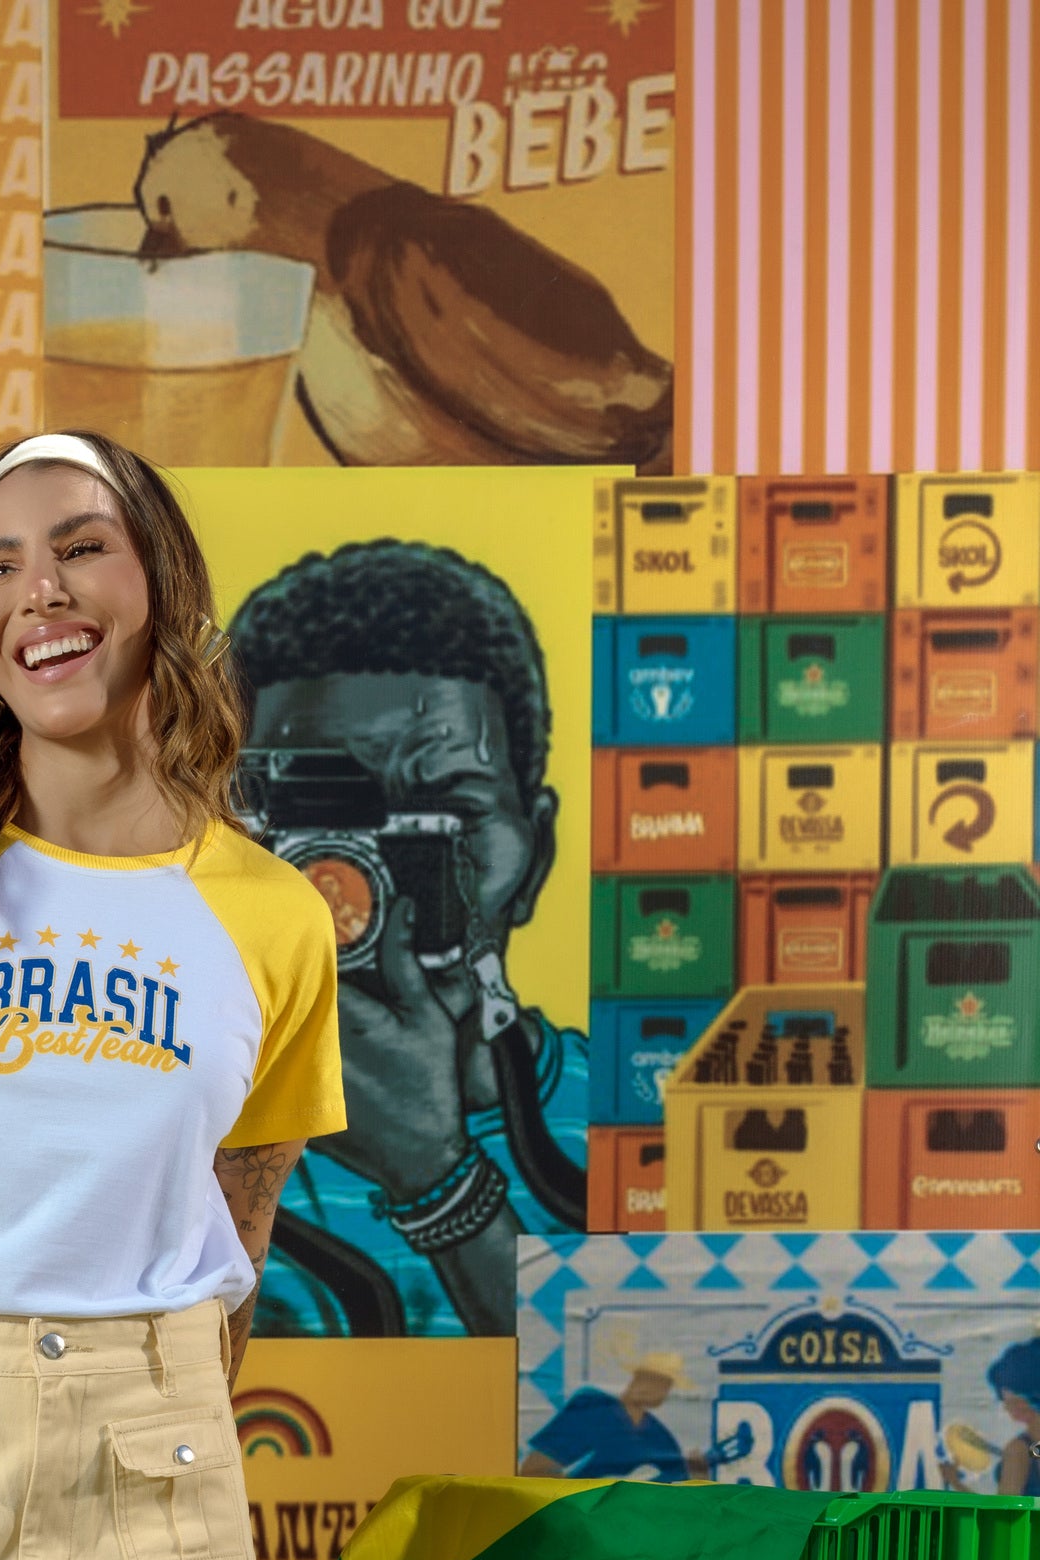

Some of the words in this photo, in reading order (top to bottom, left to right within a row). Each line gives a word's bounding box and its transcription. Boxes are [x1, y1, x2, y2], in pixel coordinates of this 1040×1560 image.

[139, 51, 483, 107] PASSARINHO
[448, 73, 676, 198] BEBE
[724, 1190, 808, 1218] DEVASSA
[779, 1328, 883, 1365] COISA
